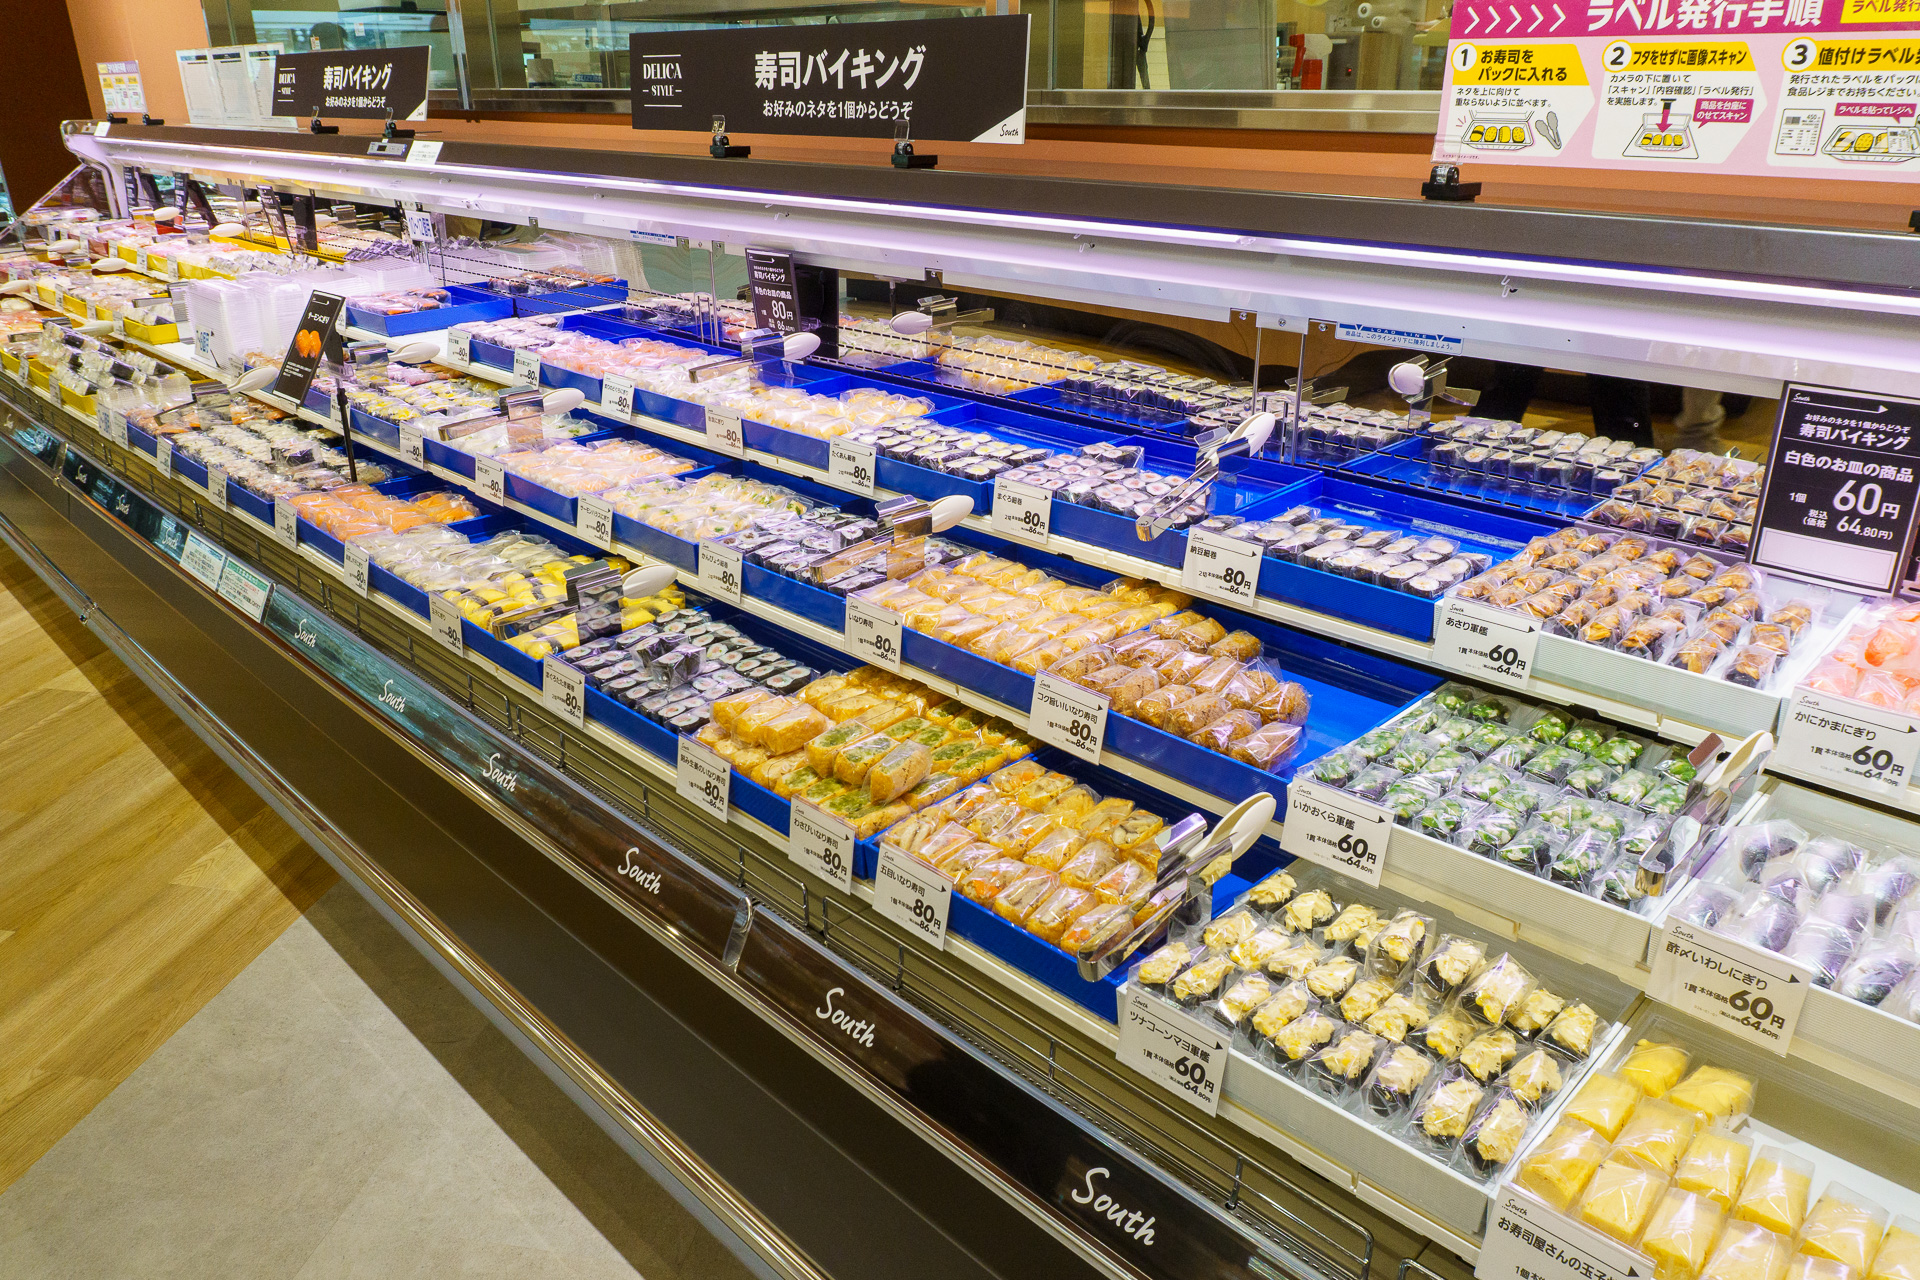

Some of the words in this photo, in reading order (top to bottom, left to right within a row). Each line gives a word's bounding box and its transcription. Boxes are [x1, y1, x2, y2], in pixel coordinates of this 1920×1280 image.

[1587, 0, 1822, 32] ラベル発行手順
[1460, 48, 1469, 67] 1
[1481, 49, 1533, 64] お寿司を
[1610, 46, 1625, 66] 2
[1633, 49, 1747, 66] フタをせずに画像スキャン
[1792, 44, 1808, 65] 3
[323, 63, 393, 90] 寿司バイキング
[643, 63, 682, 80] DELICA
[754, 45, 926, 90] 寿司バイキング
[1478, 66, 1567, 82] パックに入れる
[1610, 74, 1691, 83] カメラの下に置いて
[651, 84, 674, 97] STYLE
[1456, 87, 1520, 97] ネタを上に向けて
[1606, 97, 1657, 106] を実施します。
[762, 100, 914, 121] お好みのネタを1個からどうぞ
[1455, 98, 1552, 108] 重ならないように並べます。
[1700, 101, 1747, 110] 商品を台座に
[1838, 105, 1913, 115] ラベルを貼ってレジへ
[1697, 111, 1747, 120] のせてスキャン
[999, 123, 1019, 138] South
[1804, 413, 1911, 433] お好みのネタを1個からどうぞ
[1799, 423, 1911, 450] 寿司バイキング
[853, 465, 871, 483] 80円
[1784, 450, 1914, 483] 白色のお皿の商品
[1789, 492, 1807, 503] 1個
[1833, 480, 1901, 520] 60円
[1023, 510, 1045, 529] 80円
[722, 570, 739, 590] 80円
[1223, 567, 1251, 590] 80円
[294, 618, 318, 648] South
[1446, 617, 1488, 636] あさり軍艦
[875, 634, 897, 657] 80円
[1489, 644, 1526, 670] 60円
[378, 679, 407, 713] South
[1800, 696, 1820, 706] South
[1069, 719, 1097, 746] 80円
[1794, 711, 1877, 741] かにかまにぎり
[1852, 745, 1905, 776] 60円
[483, 753, 517, 792] South
[704, 780, 725, 806] 80円
[1293, 799, 1356, 831] いかおくら軍艦
[1337, 834, 1377, 865] 60円
[617, 847, 662, 895] South
[823, 847, 847, 876] 80円
[880, 864, 925, 897] 五目いなり寿司
[913, 898, 941, 930] 80円
[1672, 926, 1694, 940] South
[1666, 940, 1768, 991] 酢〆いわしにぎり
[815, 987, 876, 1048] South
[1729, 990, 1785, 1030] 60円
[1130, 1011, 1211, 1064] ツナコーンマヨ軍艦
[1174, 1055, 1215, 1094] 60円
[1071, 1167, 1156, 1246] South
[1505, 1198, 1528, 1216] South
